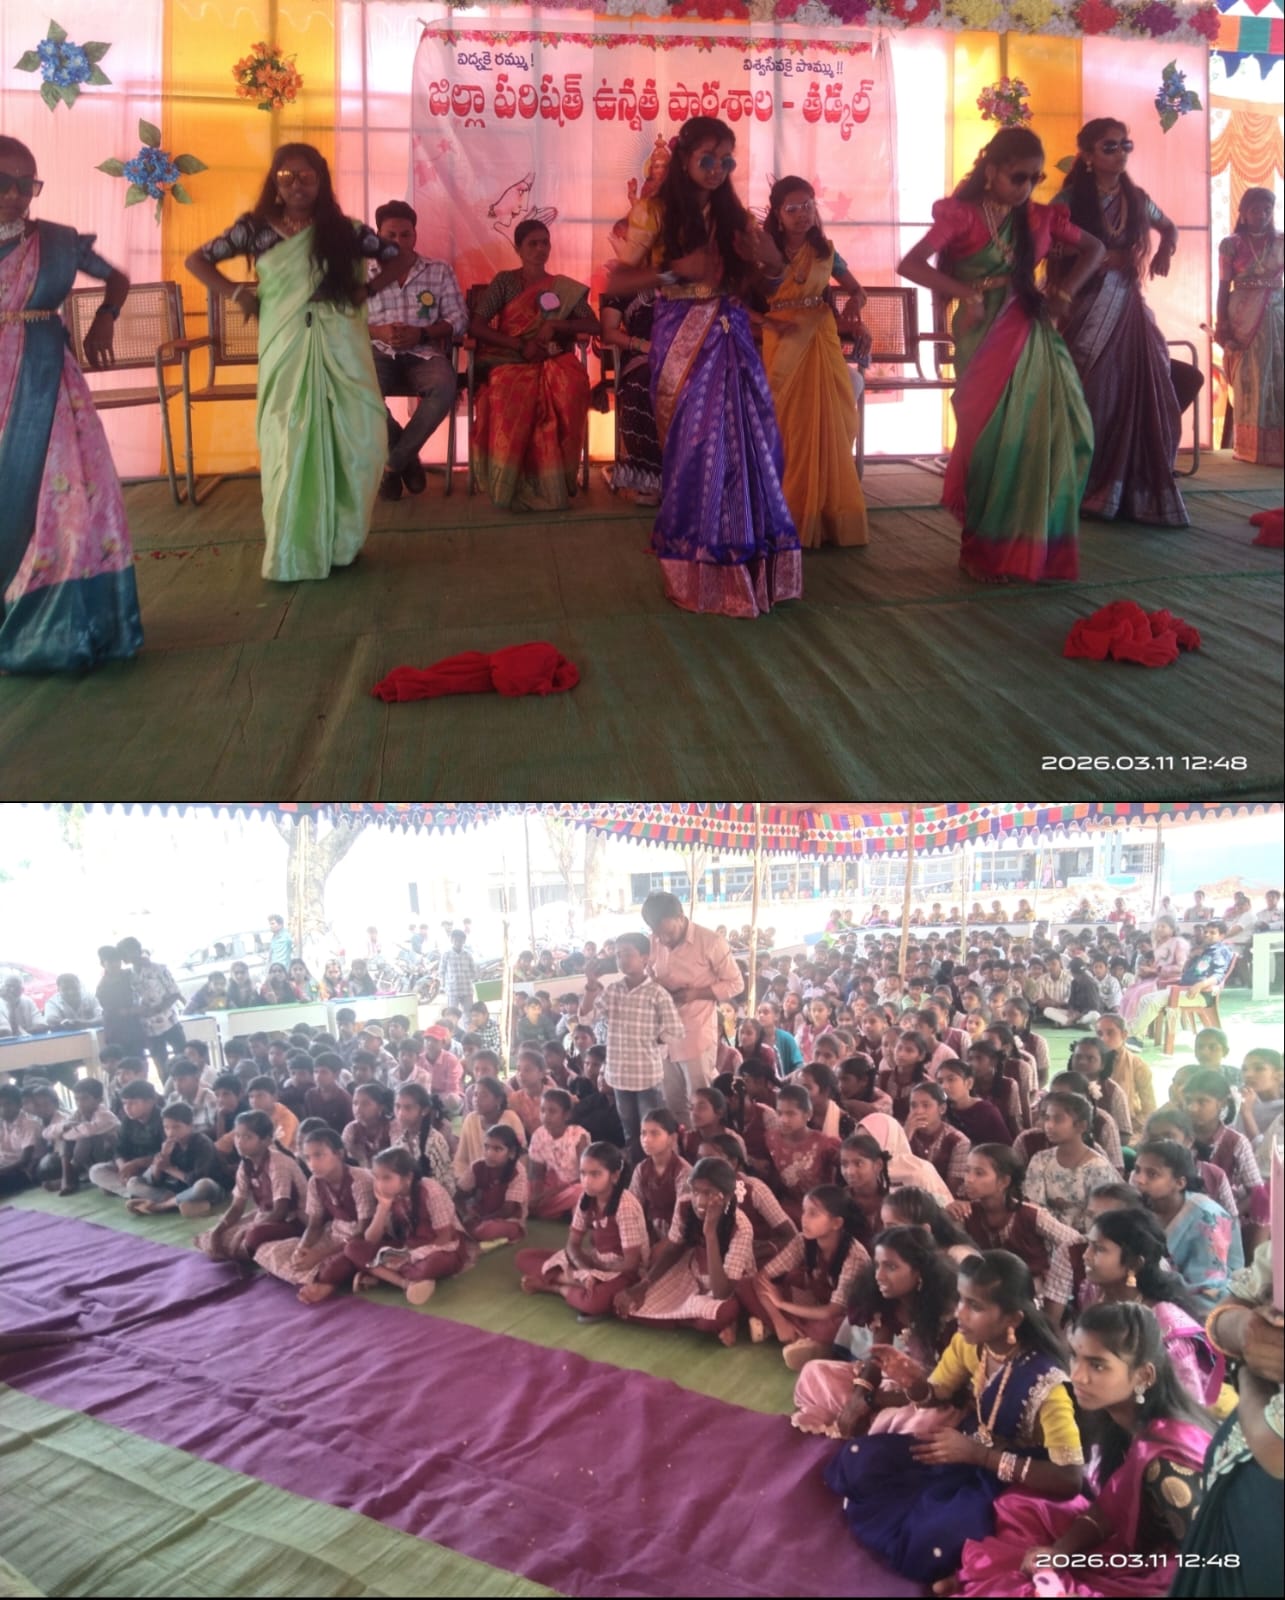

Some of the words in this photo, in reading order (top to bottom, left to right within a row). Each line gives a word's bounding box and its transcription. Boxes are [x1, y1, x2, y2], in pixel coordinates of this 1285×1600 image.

[457, 51, 493, 70] విద్యకై
[429, 78, 486, 128] జిల్లా
[494, 73, 584, 128] పరిషత్
[593, 78, 660, 131] ఉన్నత
[668, 80, 773, 122] పాఠశాల
[802, 79, 875, 141] తడ్కల్
